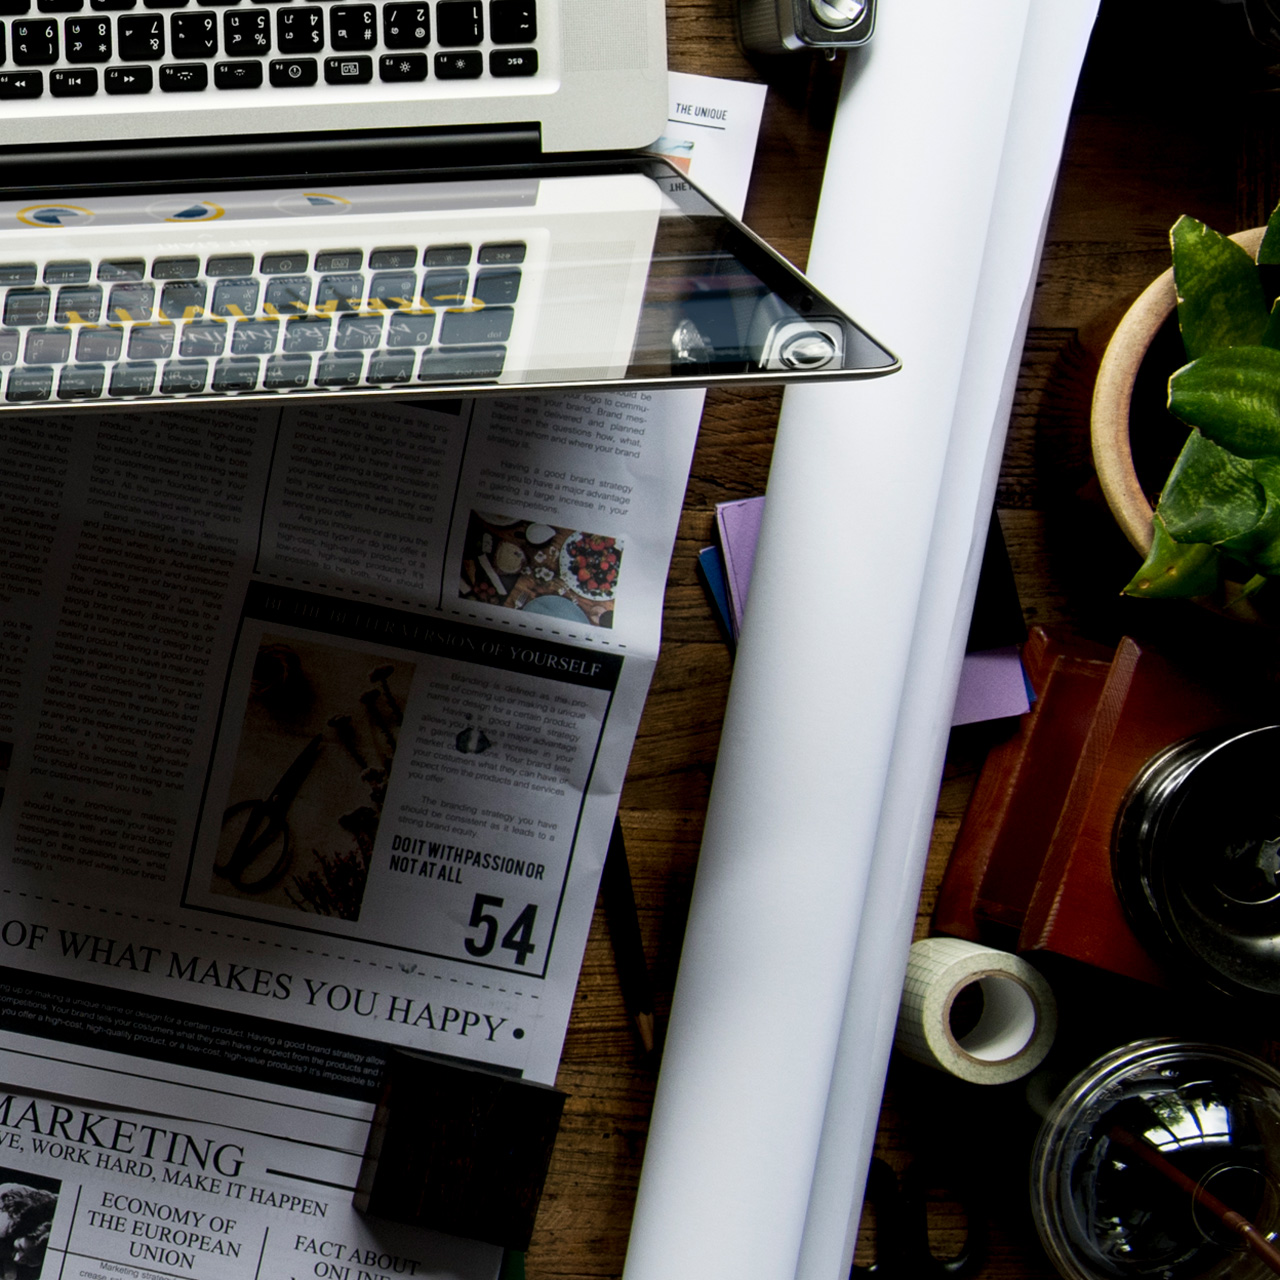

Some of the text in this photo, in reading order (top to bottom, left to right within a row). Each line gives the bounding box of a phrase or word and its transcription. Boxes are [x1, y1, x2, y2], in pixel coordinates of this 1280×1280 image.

[507, 57, 523, 66] esc
[676, 103, 728, 121] THE UNIQUE
[66, 294, 487, 331] CREATIVITY
[480, 641, 504, 657] OF
[510, 646, 602, 677] YOURSELF
[389, 854, 463, 885] NOT AT ALL
[391, 834, 545, 881] DO IT WITH PASSION OR
[463, 892, 539, 966] 54
[1, 919, 49, 951] OF
[58, 929, 162, 974] WHAT
[165, 951, 293, 1000] MAKES
[303, 978, 379, 1018] YOU
[386, 995, 507, 1042] HAPPY
[32, 1137, 91, 1166] WORK
[95, 1152, 156, 1183] HARD,
[161, 1167, 222, 1195] MAKE
[225, 1181, 247, 1199] IT
[249, 1187, 329, 1218] HAPPEN
[87, 1210, 242, 1258] THE EUROPEAN
[101, 1191, 237, 1235] ECONOMY OF
[129, 1241, 195, 1270] UNION
[294, 1235, 422, 1277] FACT ABOUT
